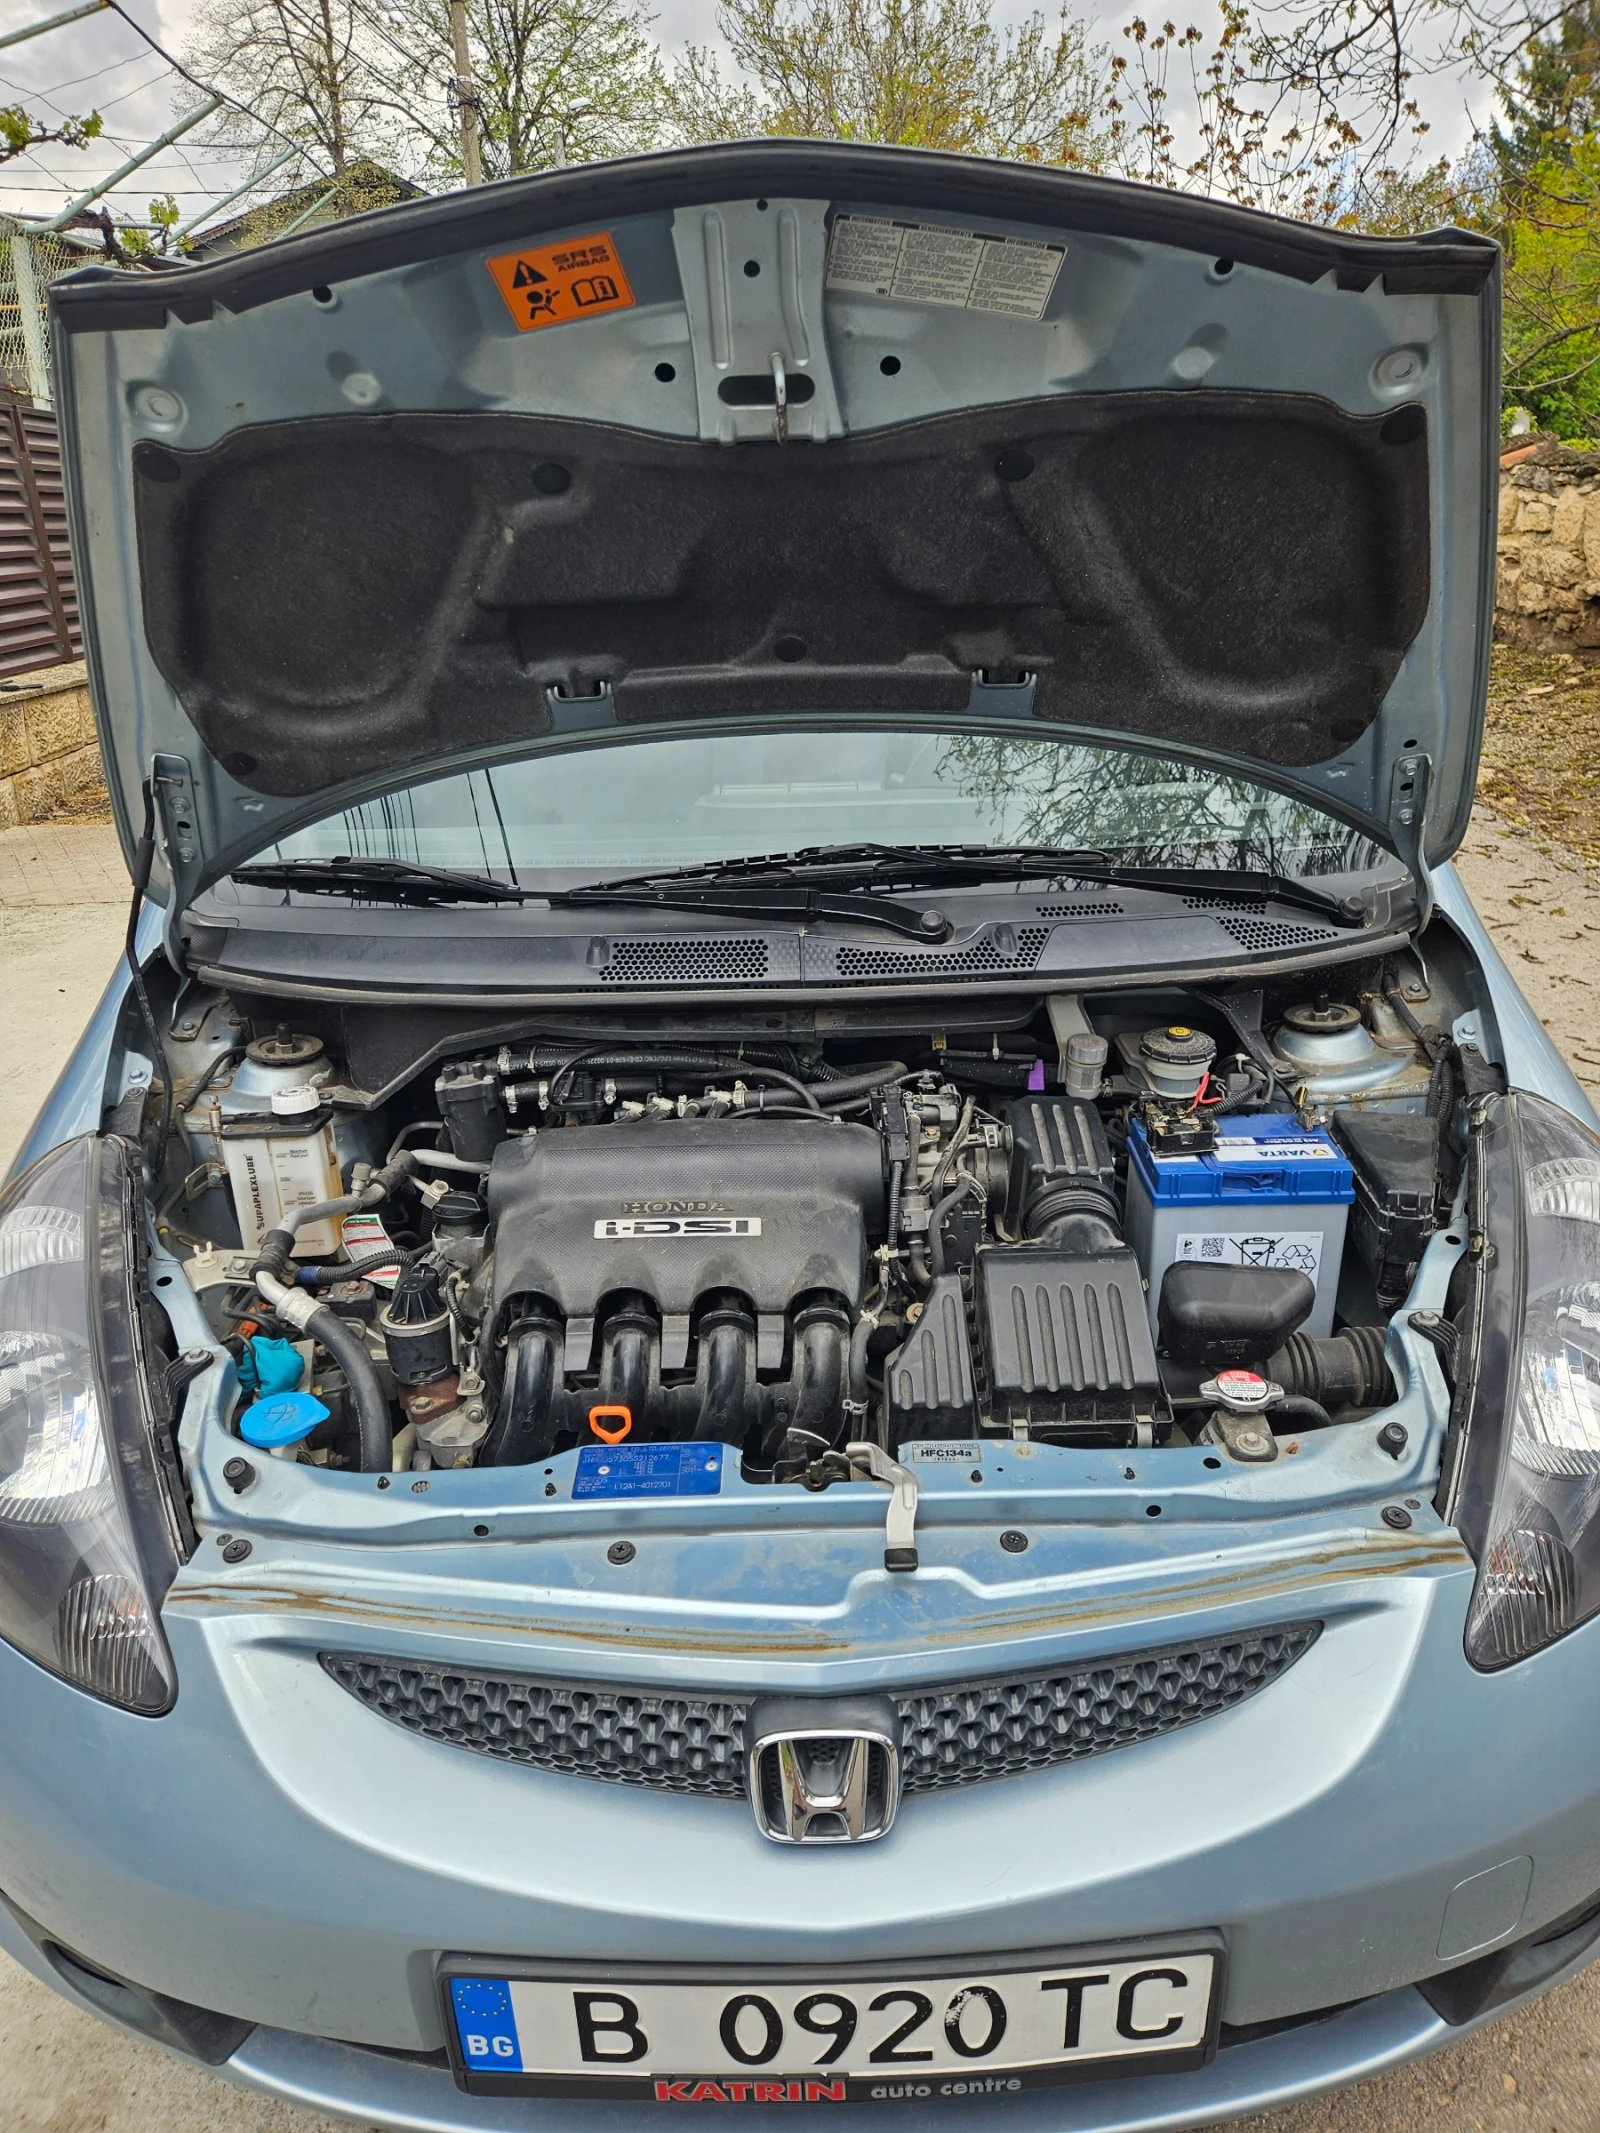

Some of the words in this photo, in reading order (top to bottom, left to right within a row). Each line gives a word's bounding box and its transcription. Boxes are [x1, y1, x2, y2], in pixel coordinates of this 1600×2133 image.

[851, 216, 891, 226] INFORMATION
[552, 245, 606, 265] SRS
[558, 255, 610, 272] AIRBAG
[246, 1155, 265, 1228] SUPAPLEXLUBE
[624, 1200, 735, 1214] HONDA
[921, 1449, 972, 1457] HFC134a
[573, 1992, 649, 2063] B
[719, 1985, 1007, 2065] 0920
[1041, 1968, 1188, 2048] TC
[467, 2034, 514, 2057] BG
[654, 2079, 847, 2102] KATRIN
[870, 2083, 931, 2099] auto
[940, 2077, 1021, 2096] centre
